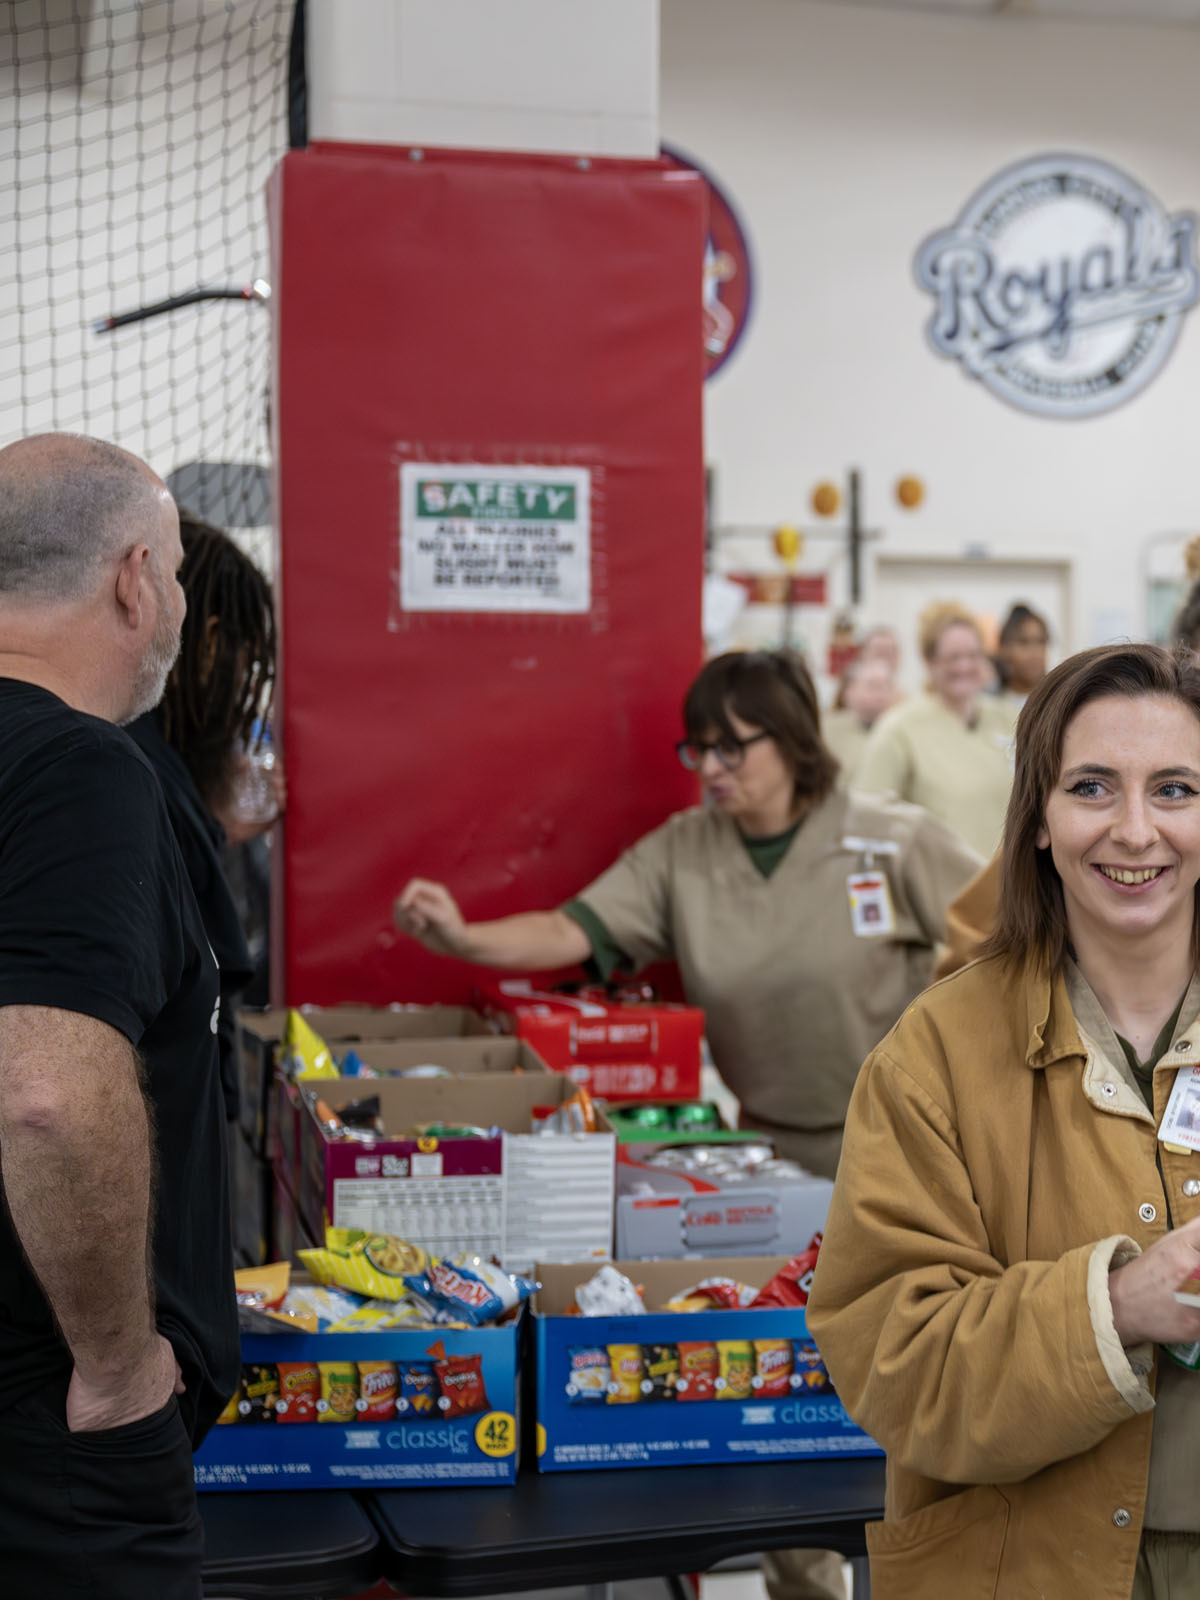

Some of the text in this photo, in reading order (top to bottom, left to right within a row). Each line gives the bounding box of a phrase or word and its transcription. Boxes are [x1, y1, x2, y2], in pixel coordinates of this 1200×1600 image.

[423, 482, 569, 515] SAFETY
[418, 542, 445, 554] NO
[435, 558, 558, 572] SLIGHT MUST
[434, 574, 561, 588] BE REPORTED
[781, 1402, 852, 1425] classi
[386, 1425, 469, 1450] classic
[485, 1419, 510, 1442] 42
